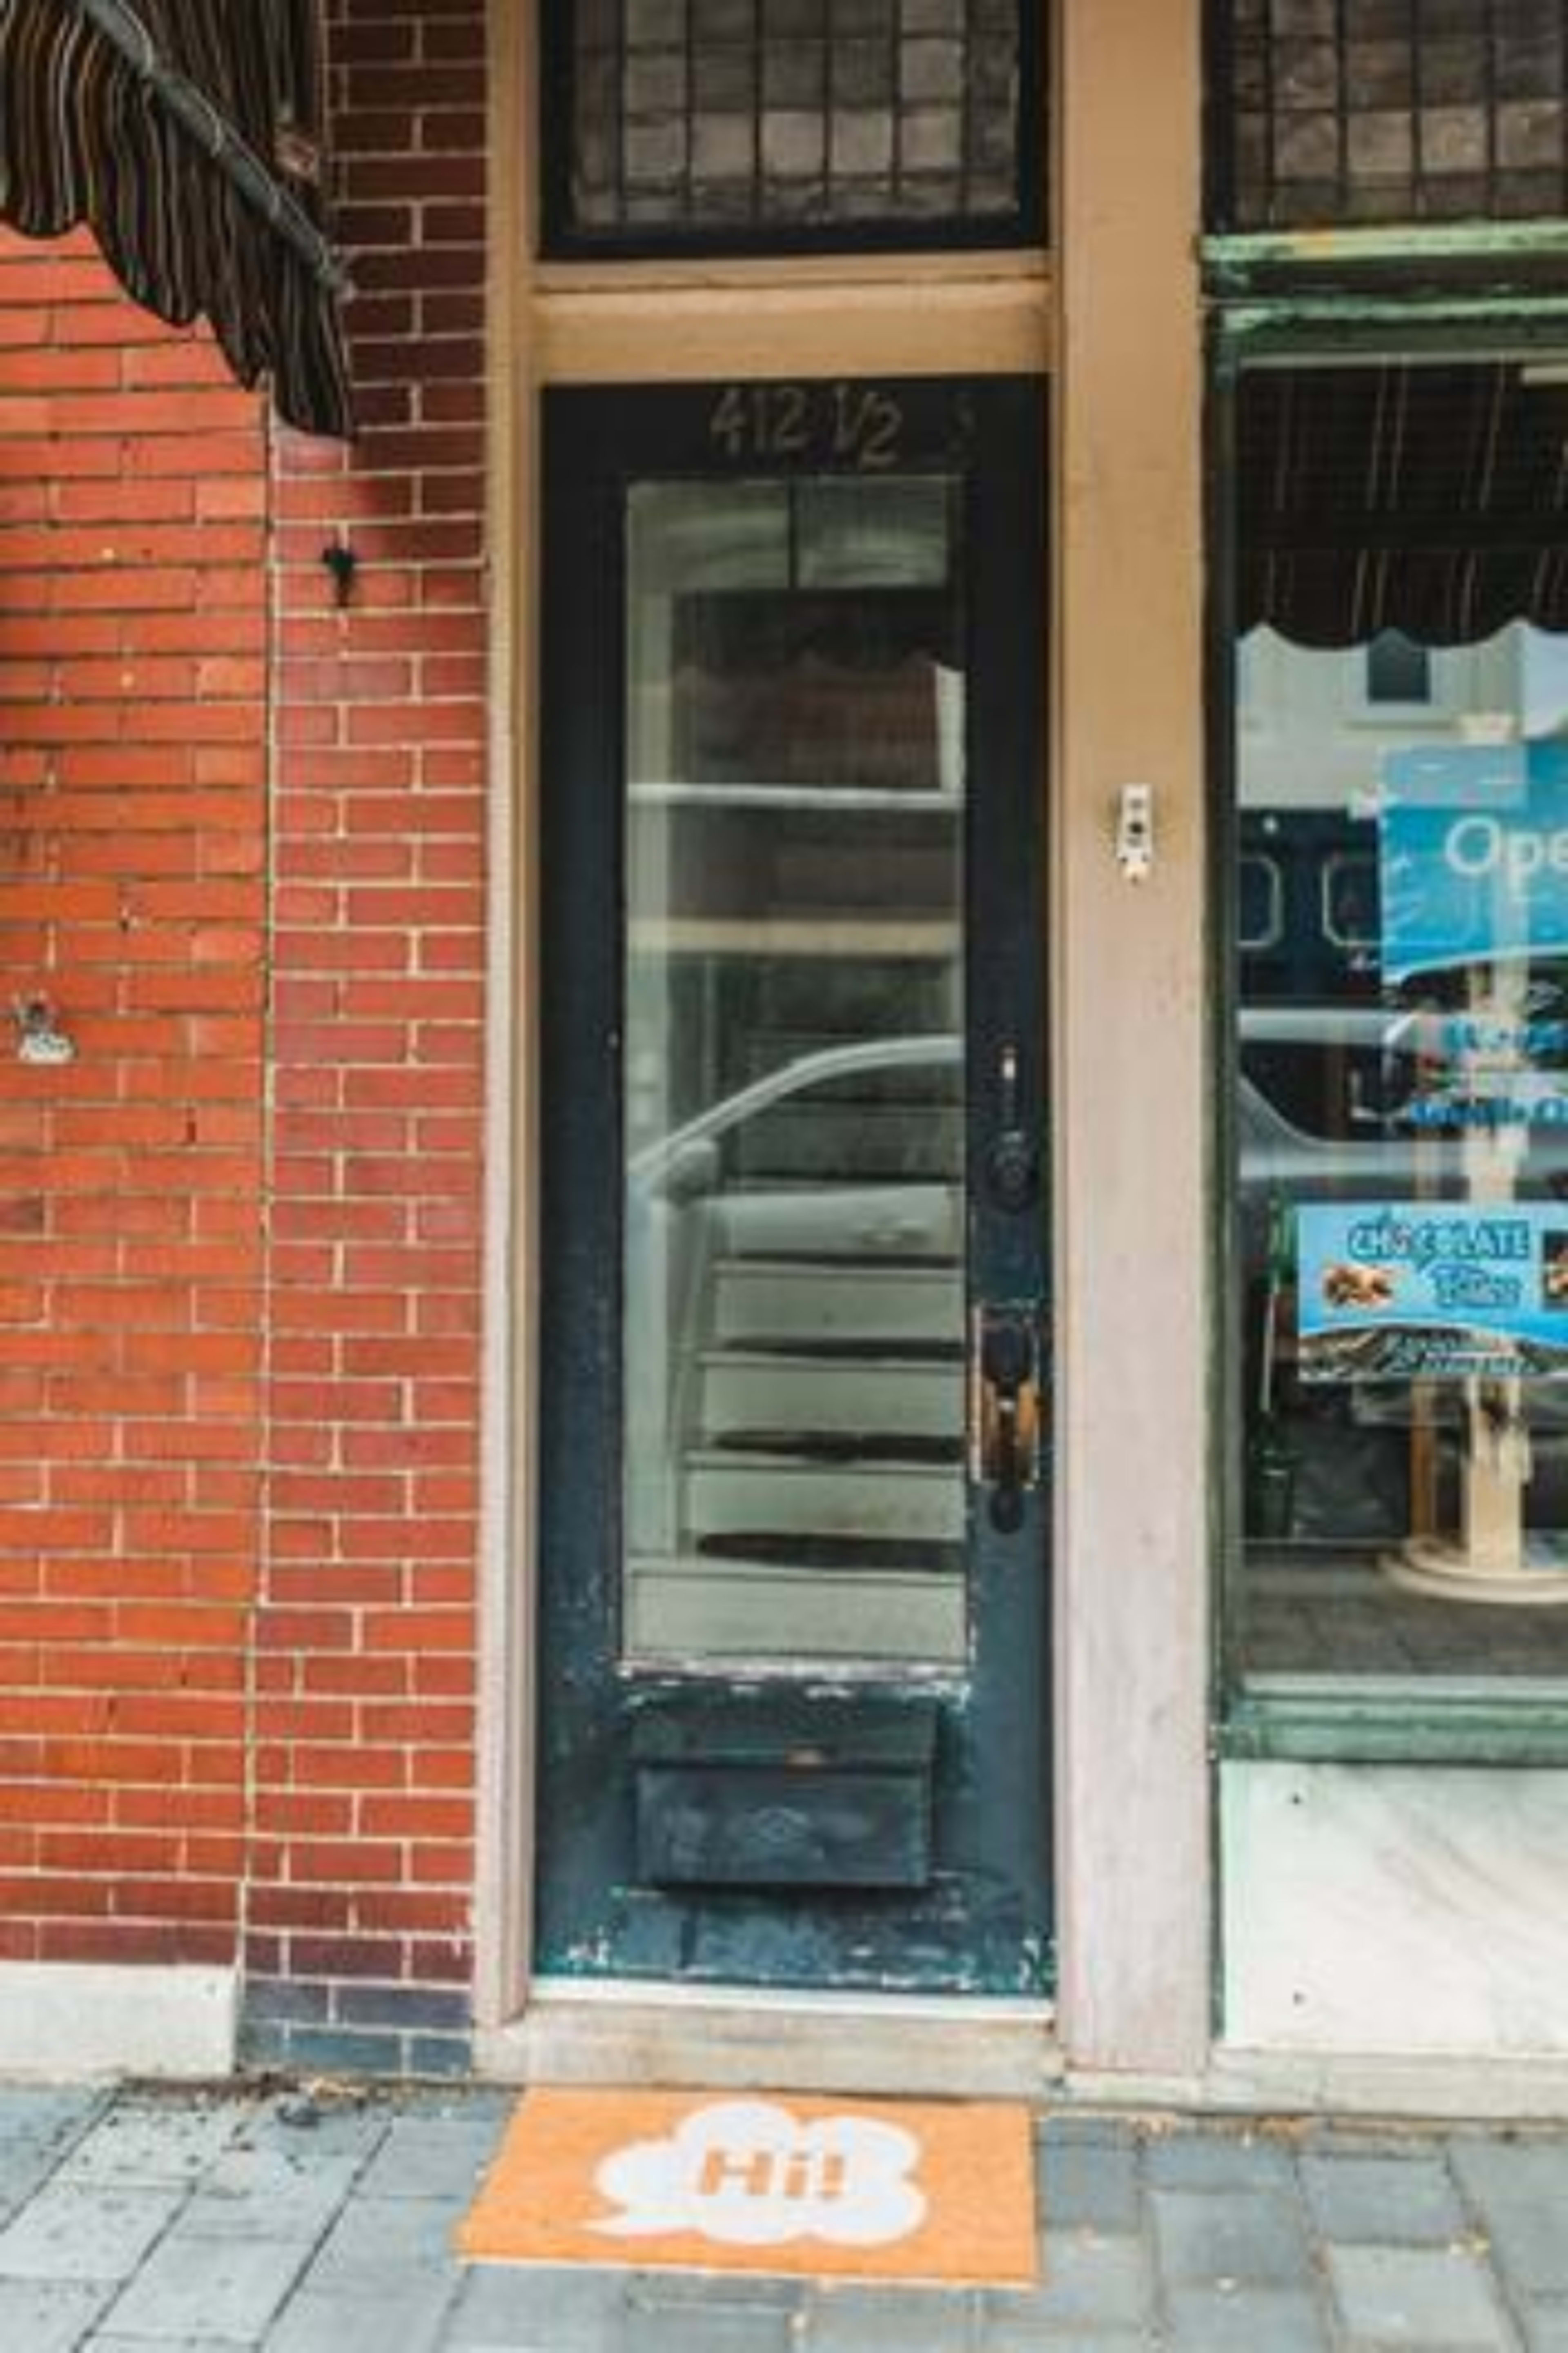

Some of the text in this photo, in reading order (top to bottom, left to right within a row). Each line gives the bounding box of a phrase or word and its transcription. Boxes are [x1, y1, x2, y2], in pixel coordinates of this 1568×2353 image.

[710, 386, 808, 456] 412
[1349, 1213, 1529, 1268] CHOCOLATE
[702, 2150, 844, 2198] Hi!
